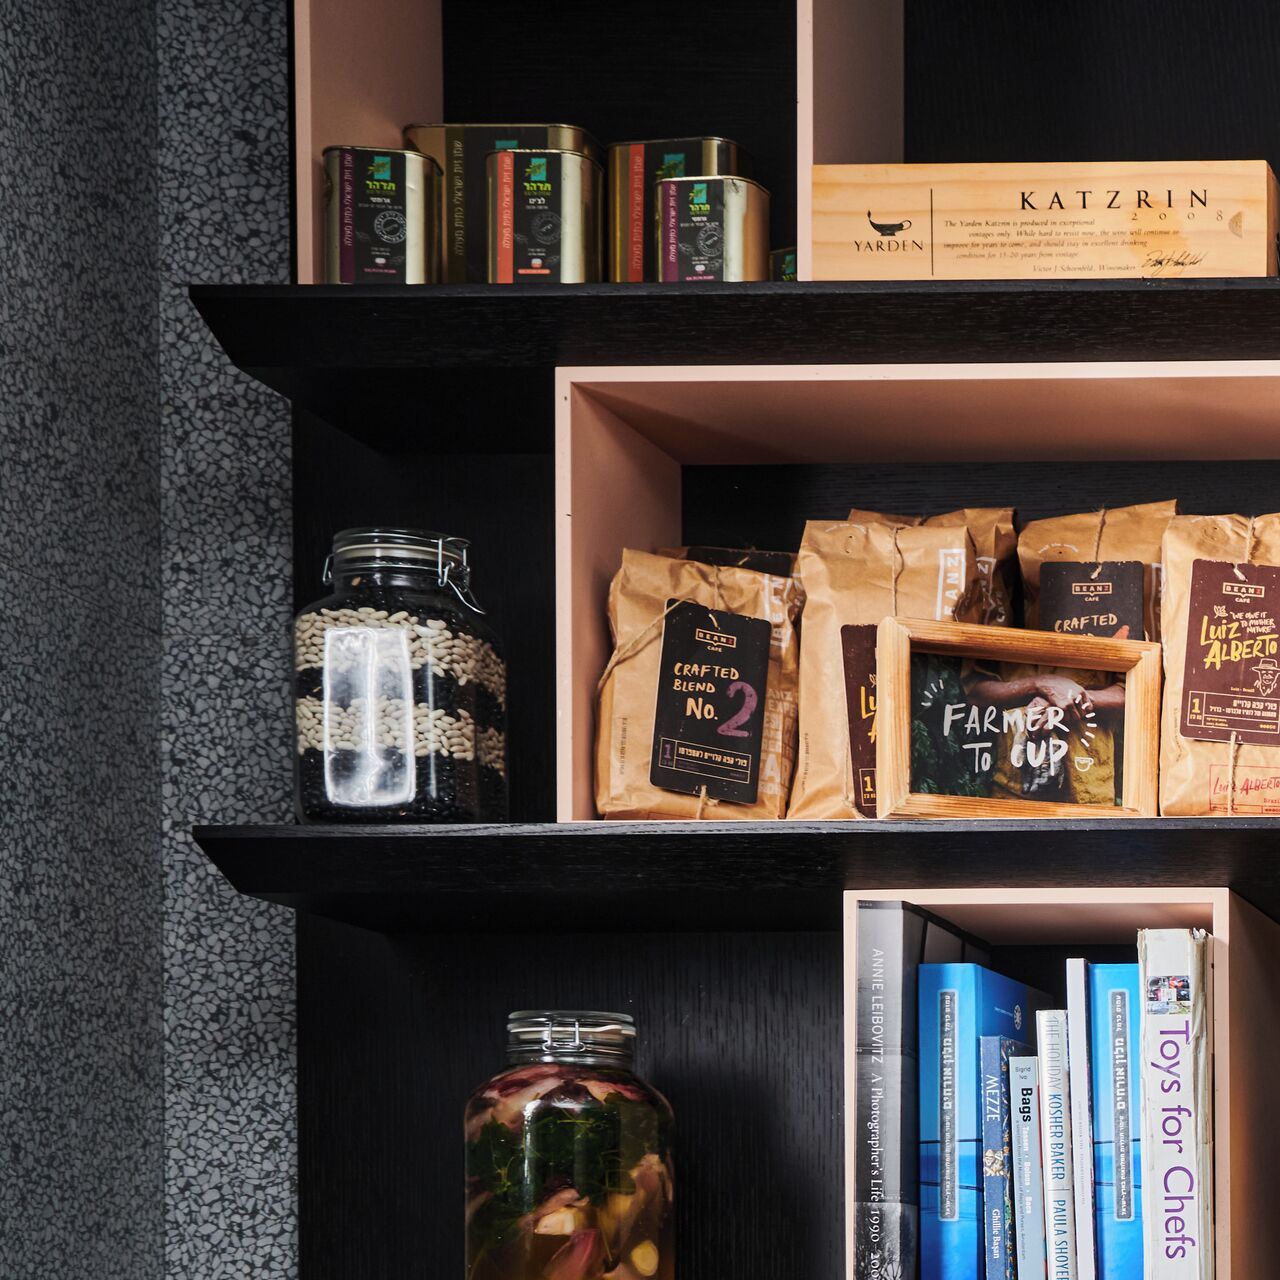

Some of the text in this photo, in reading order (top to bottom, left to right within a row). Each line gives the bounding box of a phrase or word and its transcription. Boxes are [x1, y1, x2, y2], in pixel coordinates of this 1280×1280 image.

[1020, 189, 1208, 210] KATZRIN
[1131, 210, 1223, 222] 2008
[854, 239, 925, 253] YARDEN
[1226, 585, 1261, 594] BEANZ
[1054, 613, 1118, 633] CRAFTED
[1203, 634, 1280, 671] ALBERTO
[673, 679, 716, 694] BLEND
[674, 662, 740, 680] CRAFTED
[716, 681, 758, 738] 2
[943, 702, 1070, 737] FARMER
[1010, 738, 1068, 777] CUP
[872, 948, 884, 990] ANNIE
[872, 996, 884, 1064] LEIBOVITZ
[942, 1038, 955, 1063] מלון
[1047, 1043, 1061, 1090] HOLIDAY
[1113, 1038, 1126, 1063] מלון
[871, 1072, 883, 1082] A
[943, 1067, 952, 1109] אורחים
[1116, 1066, 1126, 1110] אורחים
[986, 1074, 1001, 1122] MEZZE
[1019, 1087, 1032, 1122] Bags
[866, 1088, 884, 1176] Photographer's
[1048, 1094, 1064, 1138] KOSHER
[1151, 1020, 1196, 1259] Toys for Chefs
[1050, 1143, 1065, 1180] BAKER
[870, 1179, 884, 1202] Life
[868, 1210, 880, 1242] 1990
[992, 1209, 1001, 1233] Ghillie
[1052, 1199, 1067, 1236] PAULA
